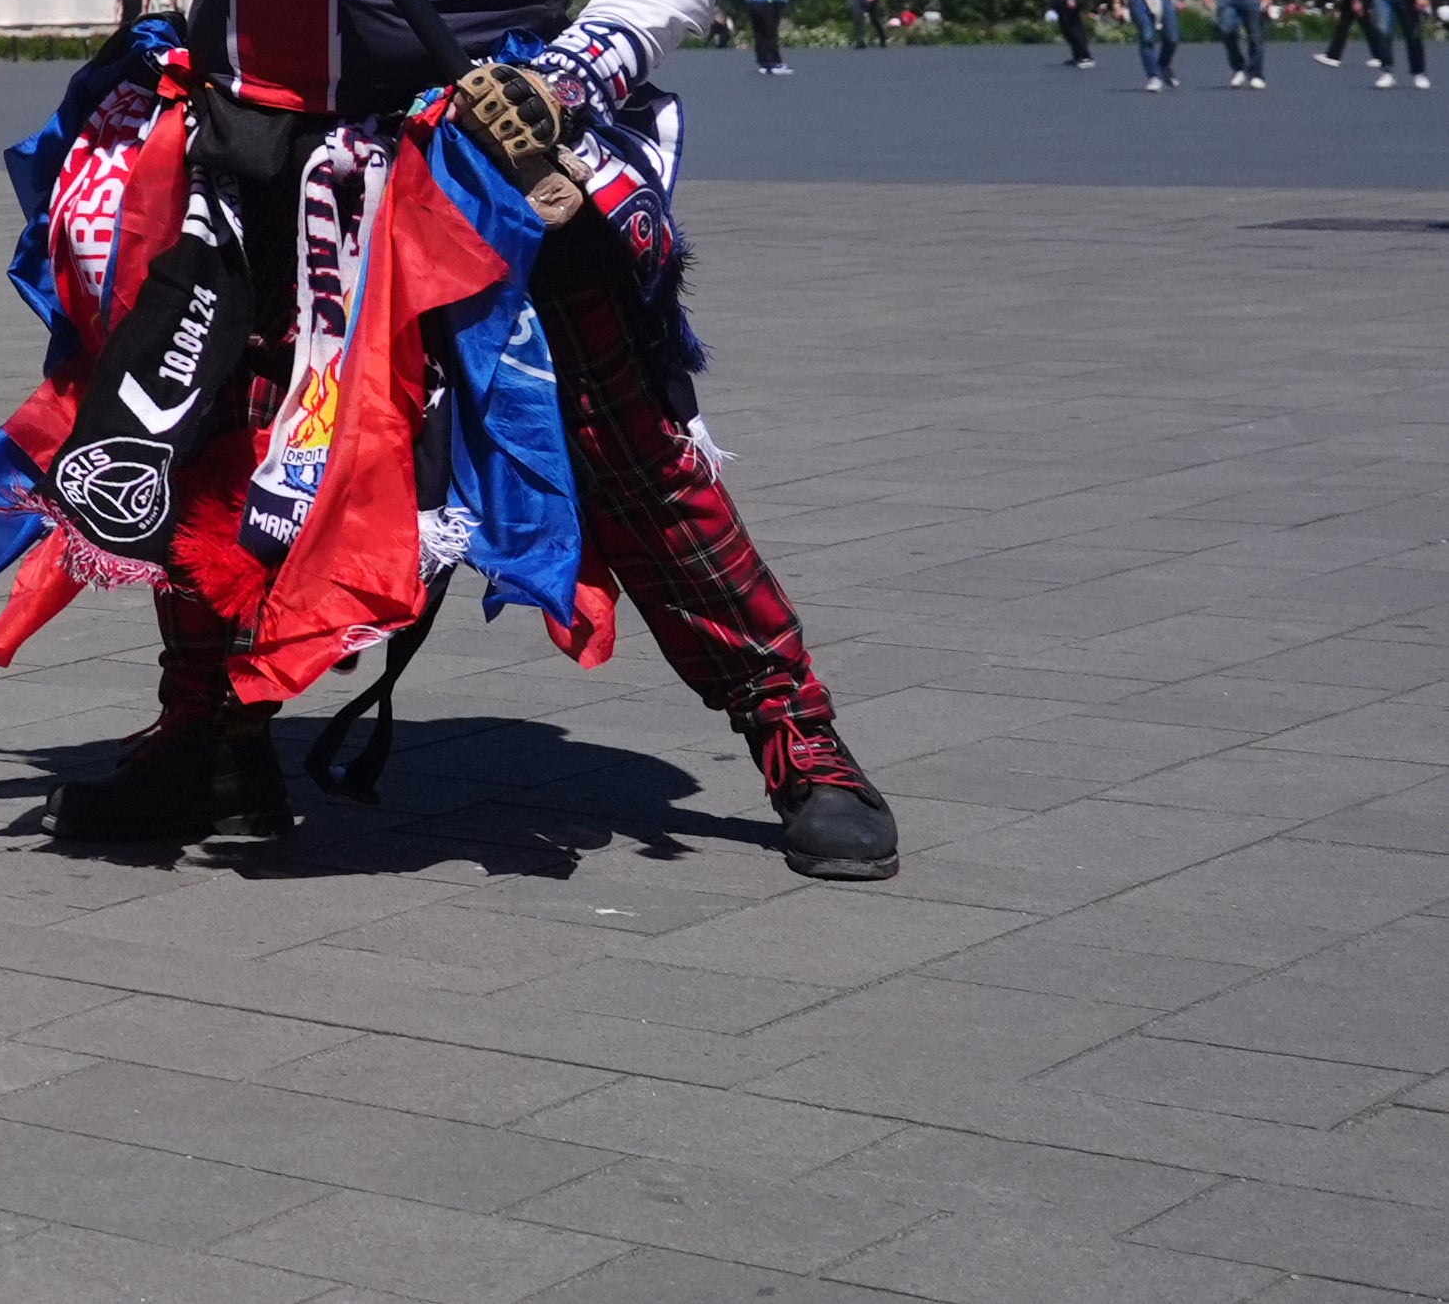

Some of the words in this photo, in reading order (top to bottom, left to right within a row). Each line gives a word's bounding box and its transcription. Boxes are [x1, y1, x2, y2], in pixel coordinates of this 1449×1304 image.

[158, 283, 218, 387] 10.04.24
[62, 448, 111, 505] PARIS
[286, 448, 323, 463] DROIT
